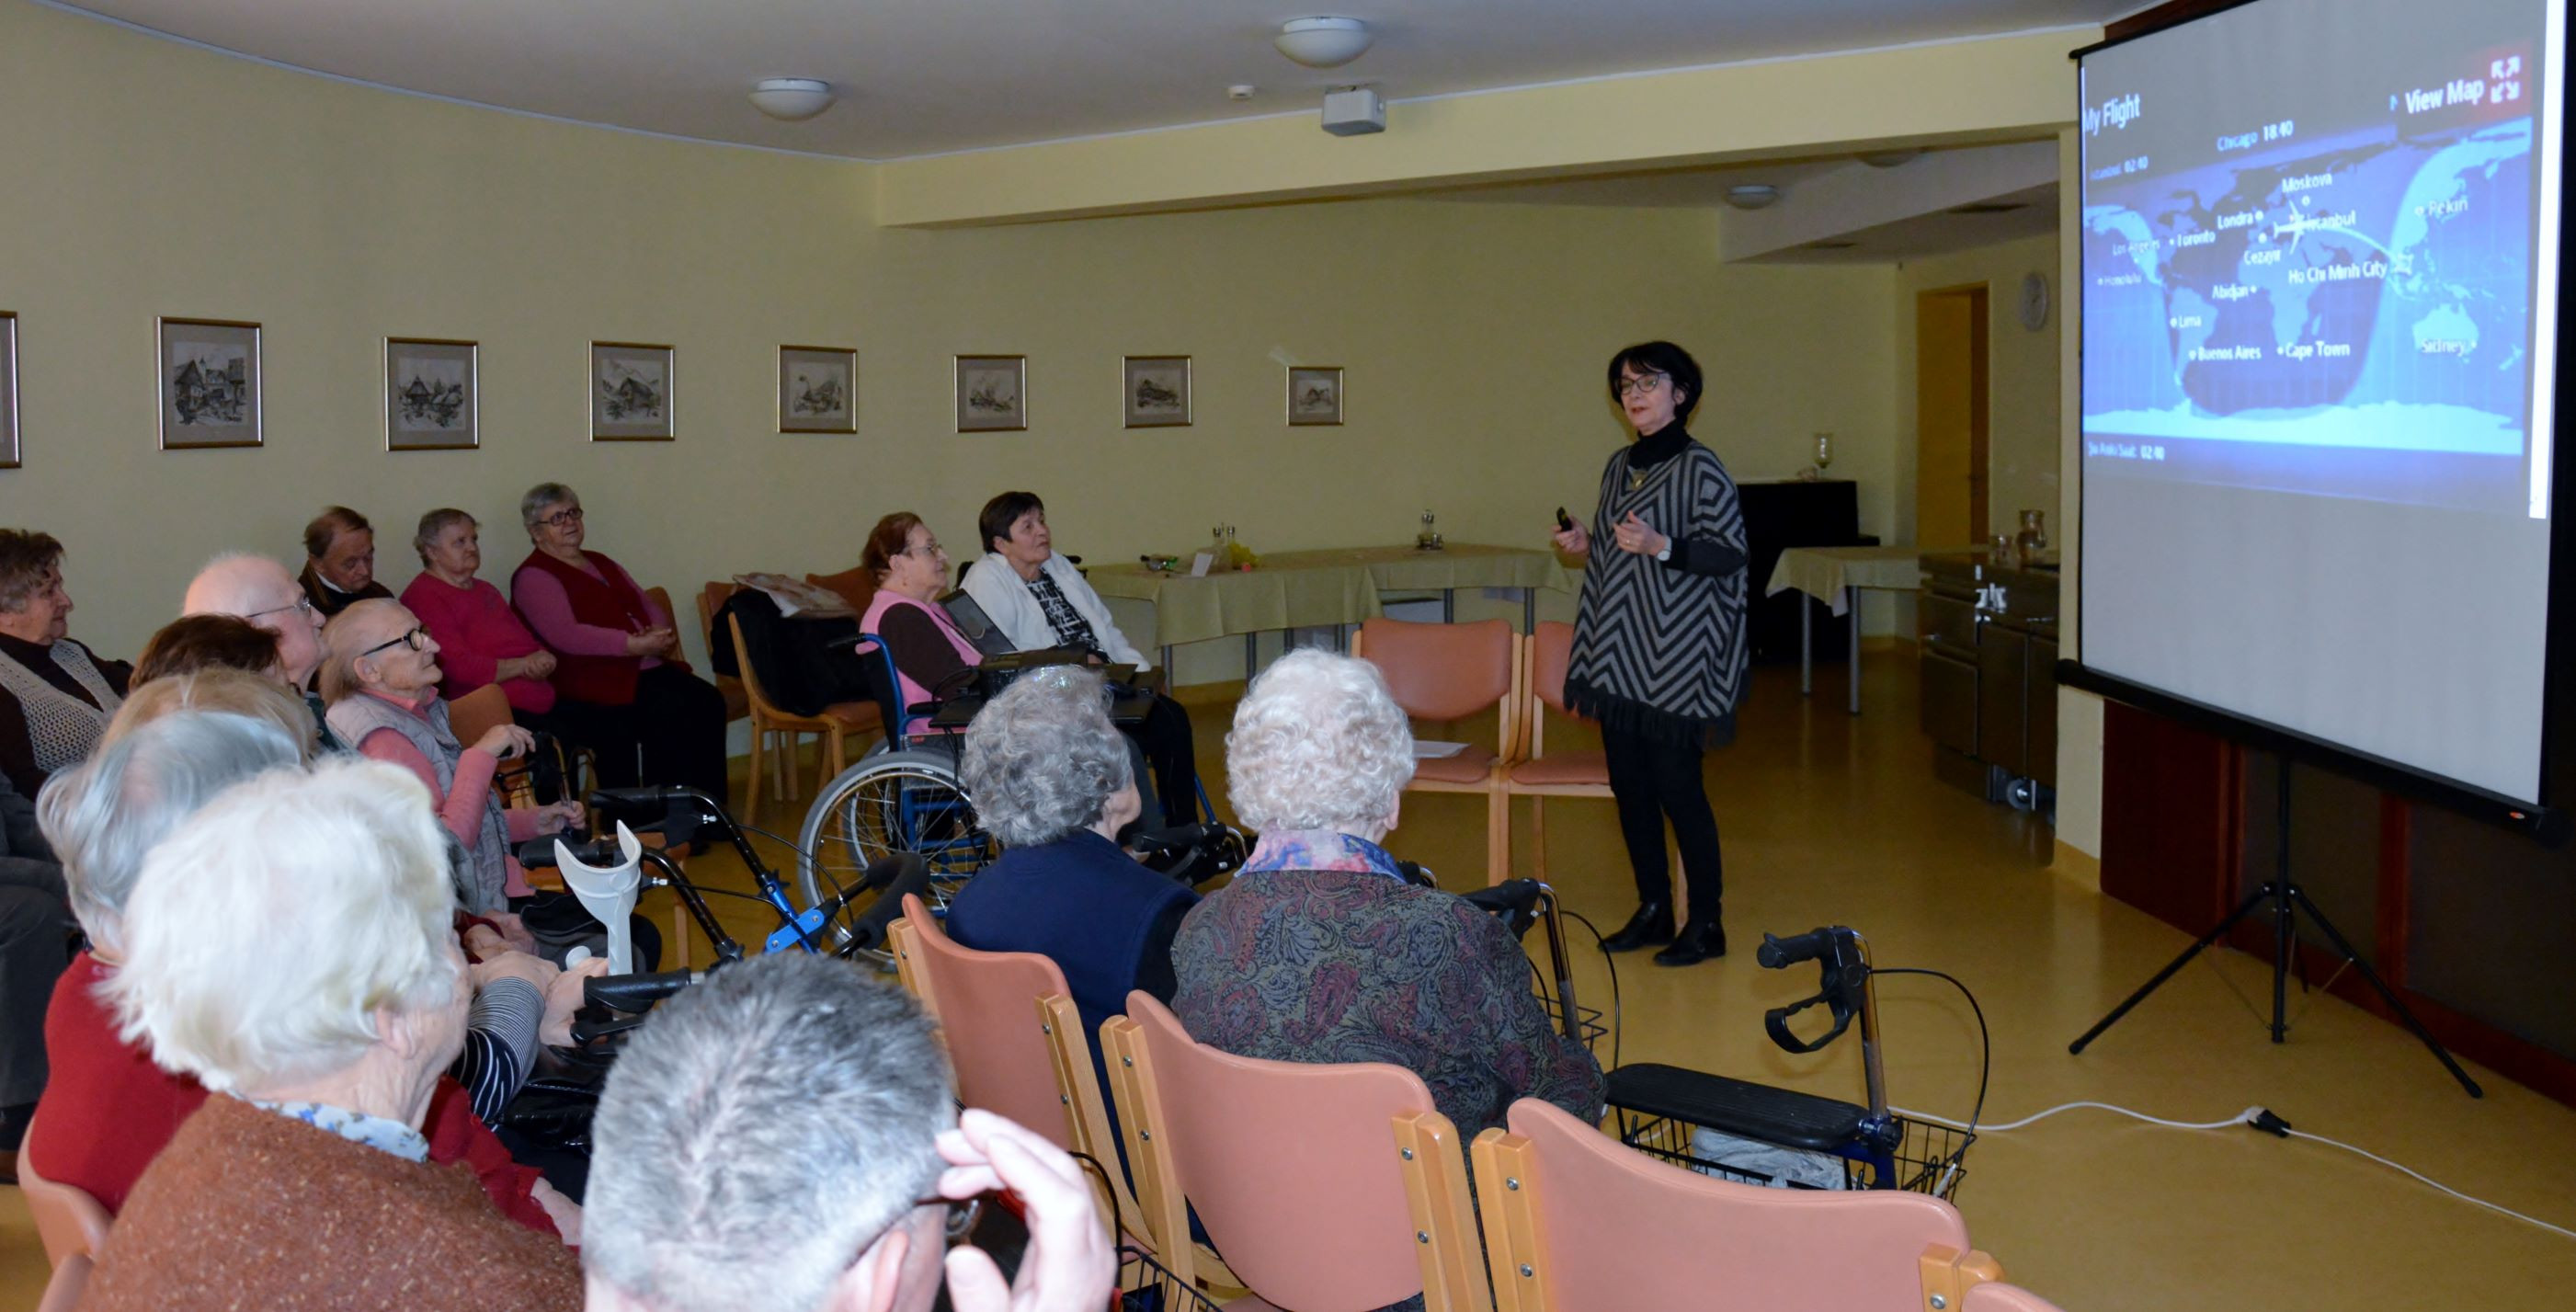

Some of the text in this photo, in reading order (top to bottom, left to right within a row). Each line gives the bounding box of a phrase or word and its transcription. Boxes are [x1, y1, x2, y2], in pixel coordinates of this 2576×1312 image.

[2405, 79, 2485, 114] View Map
[2103, 94, 2140, 129] Flight
[2217, 132, 2258, 152] Chicago
[2282, 174, 2332, 193] Moskova
[2217, 214, 2253, 230] Londra
[2288, 261, 2388, 284] Ho Chi Minh City
[2179, 316, 2203, 328] Lima
[2198, 345, 2262, 361] Buenos Aires
[2285, 340, 2351, 361] Cape Town
